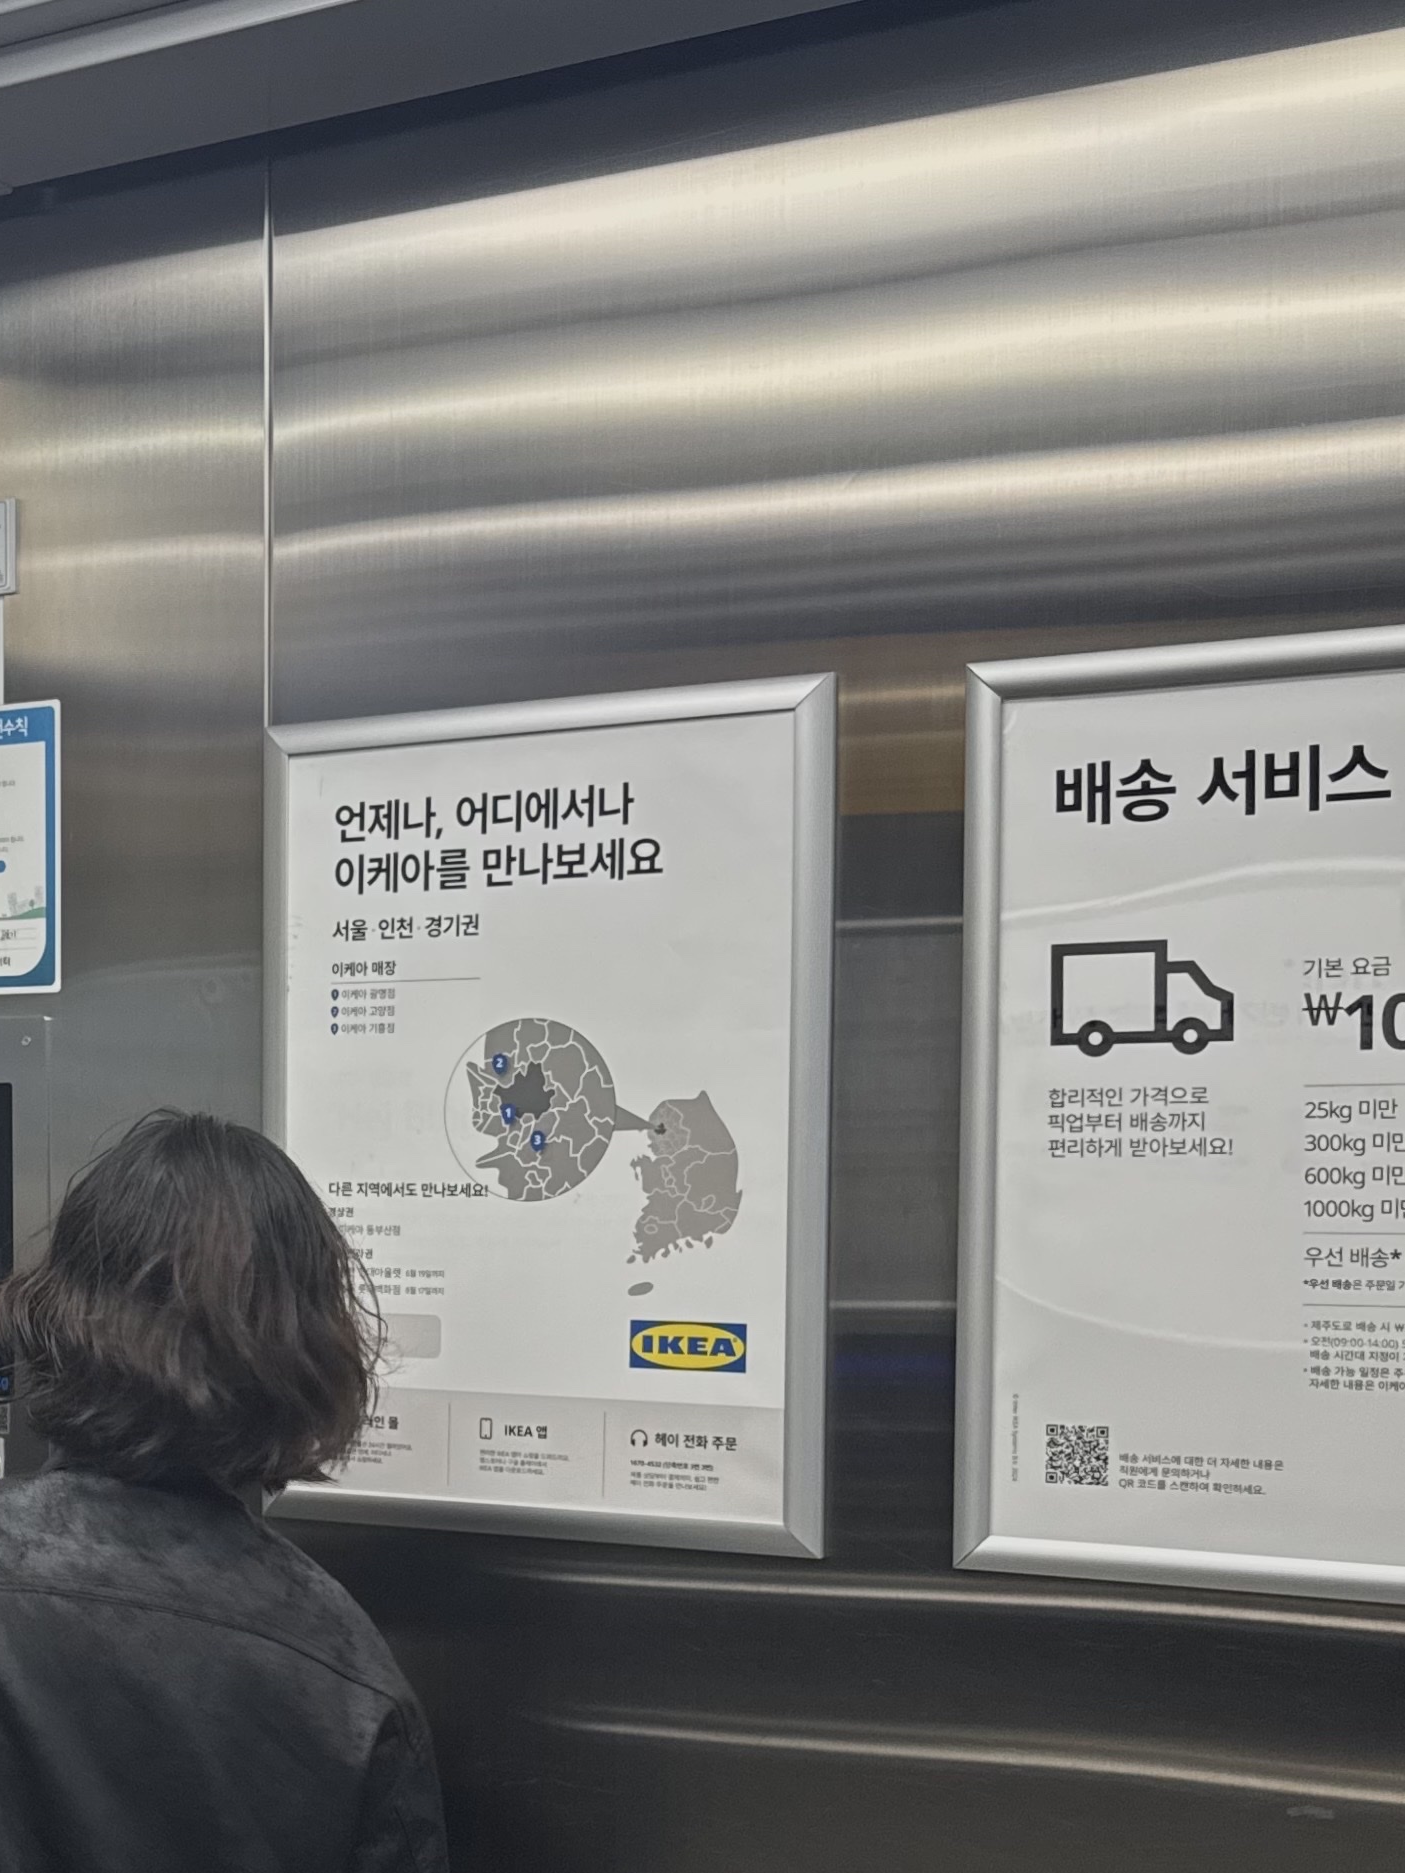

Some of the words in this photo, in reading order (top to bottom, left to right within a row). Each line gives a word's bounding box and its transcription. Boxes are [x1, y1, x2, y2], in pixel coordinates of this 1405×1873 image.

[1056, 758, 1177, 825] 배송
[1196, 744, 1392, 816] 서비스
[335, 797, 443, 843] 언제나,
[455, 782, 634, 835] 어디에서나
[335, 848, 471, 895] 이케아를
[482, 838, 663, 887] 만나보세요
[332, 961, 368, 977] 이케아
[371, 960, 397, 976] 매장
[1303, 957, 1344, 978] 기본
[1350, 956, 1392, 977] 요금
[1048, 1086, 1123, 1108] 합리적인
[1129, 1085, 1209, 1107] 가격으로
[1304, 1100, 1352, 1123] 25kg
[1359, 1098, 1399, 1120] 미만
[1047, 1112, 1122, 1133] 픽업부터
[1129, 1111, 1205, 1132] 배송까지
[1047, 1137, 1122, 1158] 편리하게
[1129, 1136, 1233, 1158] 받아보세요!
[1304, 1131, 1366, 1156] 300kg
[1304, 1165, 1366, 1189] 600kg
[328, 1182, 353, 1197] 다른
[356, 1182, 418, 1197] 지역에서도
[421, 1182, 489, 1198] 만나보세요!
[1303, 1199, 1374, 1222] 1000kg
[1381, 1198, 1405, 1219] 미
[1303, 1246, 1343, 1268] 우선
[1331, 1278, 1362, 1291] 배송은
[1365, 1280, 1396, 1291] 주문일
[1311, 1320, 1352, 1331] 제주도로
[1356, 1321, 1376, 1332] 배송
[1380, 1322, 1391, 1333] 시
[641, 1334, 737, 1357] IKEA
[1309, 1350, 1330, 1360] 배송
[1334, 1350, 1365, 1361] 시간대
[1310, 1365, 1331, 1376] 배송
[1359, 1367, 1390, 1379] 일정은
[1308, 1378, 1340, 1390] 자세한
[1343, 1379, 1375, 1391] 내용은
[504, 1425, 533, 1437] IKEA
[536, 1425, 548, 1439] 앱
[655, 1432, 679, 1448] 헤이
[683, 1434, 708, 1450] 전화
[712, 1436, 737, 1451] 주문
[1119, 1453, 1139, 1464] 배송
[1184, 1455, 1204, 1466] 대한
[1119, 1478, 1134, 1489] QR
